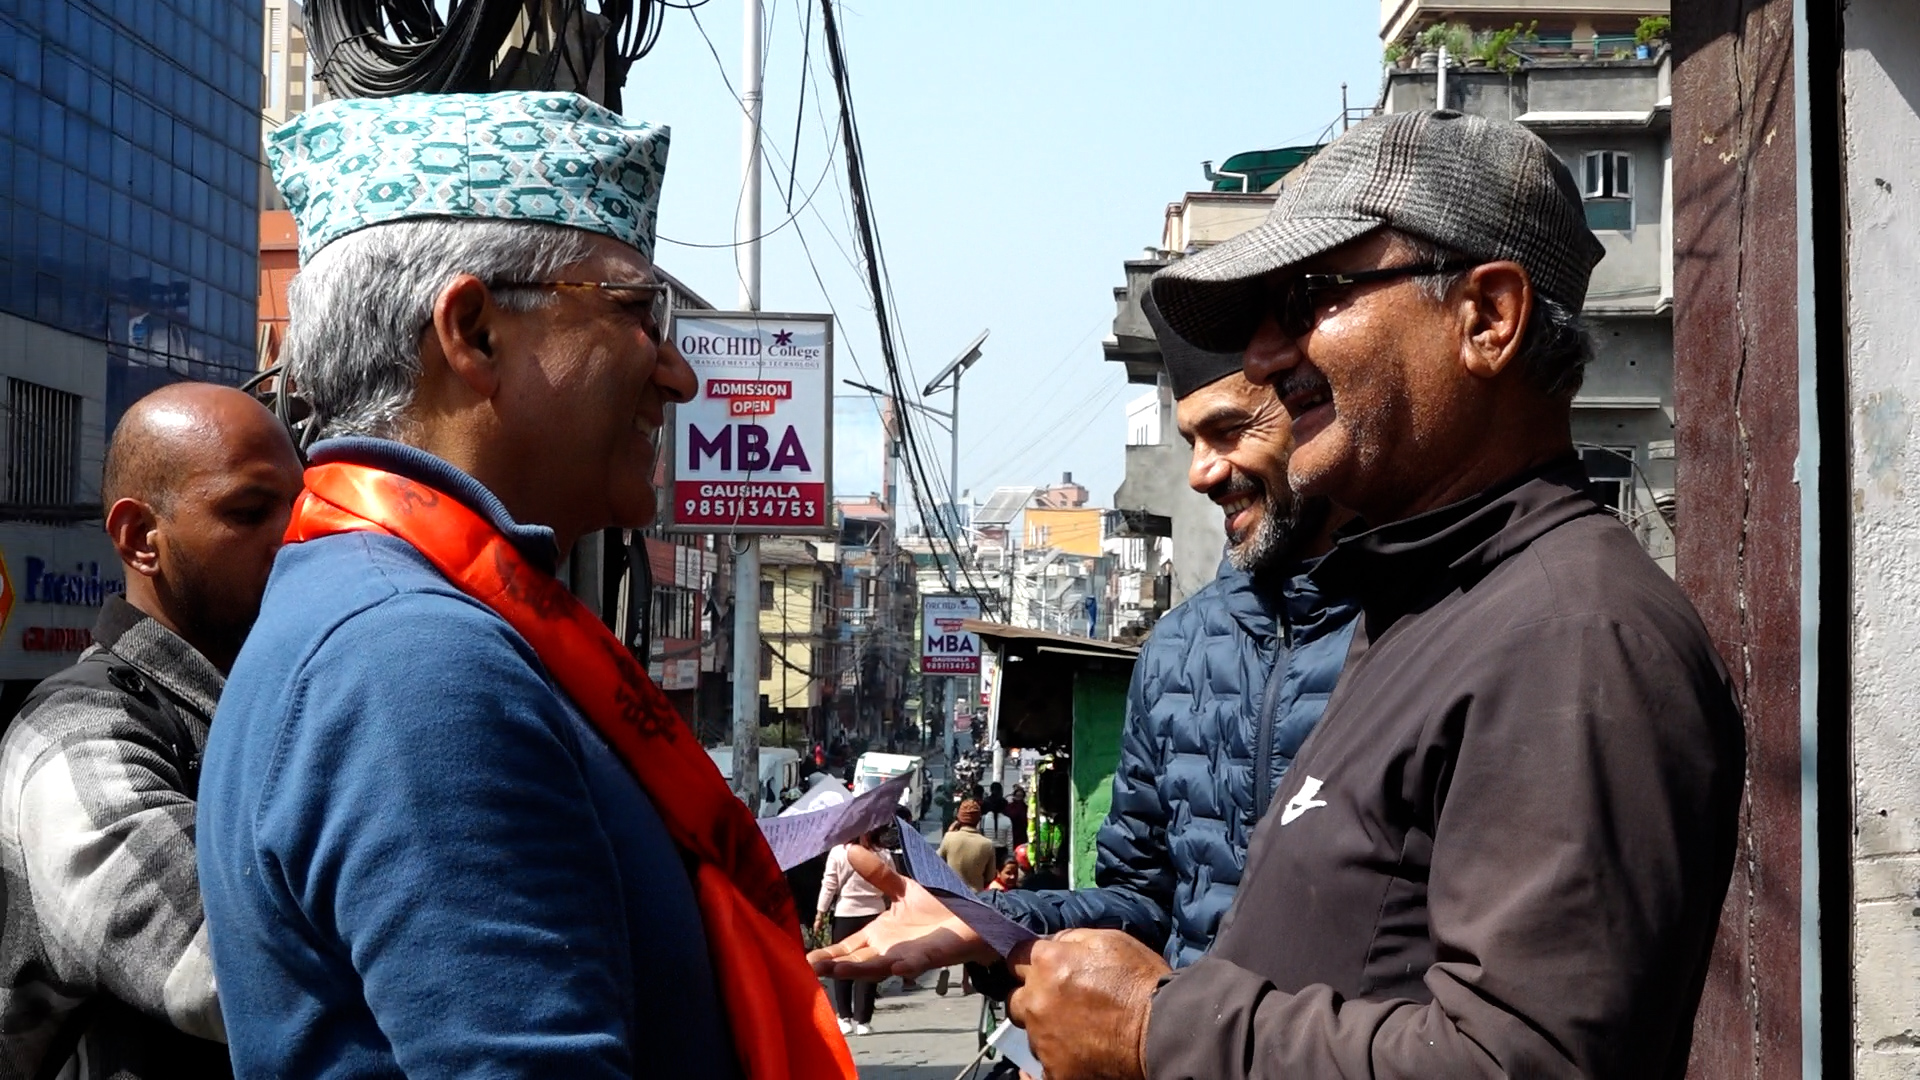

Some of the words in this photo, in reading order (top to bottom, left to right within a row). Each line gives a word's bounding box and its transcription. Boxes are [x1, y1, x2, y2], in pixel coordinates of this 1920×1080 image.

[682, 336, 761, 356] ORCHID
[768, 344, 819, 359] College
[694, 359, 748, 367] MANAGEMENT
[751, 359, 767, 367] AND
[711, 382, 787, 397] ADMISSION
[732, 400, 770, 413] OPEN
[689, 423, 812, 472] MBA
[700, 485, 800, 498] GAUSHALA
[685, 500, 815, 517] 9851134753
[928, 635, 973, 652] MBA
